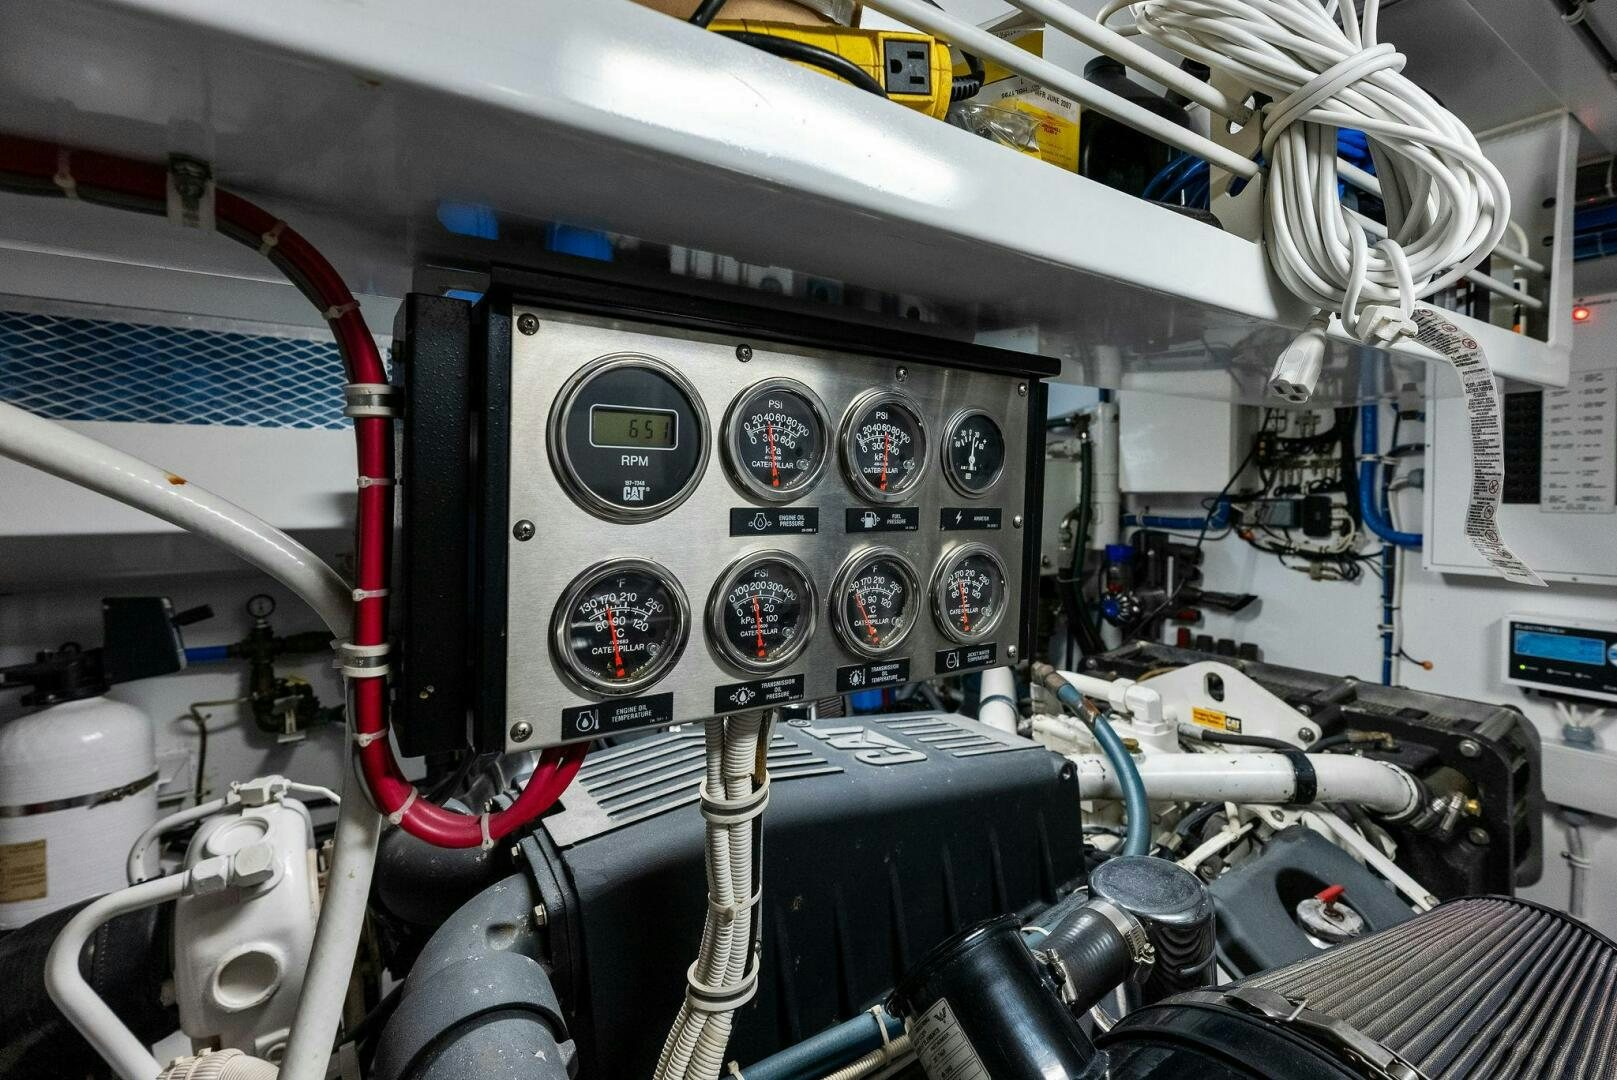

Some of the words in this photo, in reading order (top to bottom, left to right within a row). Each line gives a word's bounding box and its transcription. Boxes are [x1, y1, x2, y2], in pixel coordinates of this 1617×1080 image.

[1046, 94, 1060, 105] JUNE
[768, 399, 783, 410] PSI
[875, 411, 889, 420] PSI
[743, 422, 751, 431] 0
[752, 413, 763, 424] 20
[763, 412, 775, 421] 40
[775, 413, 787, 422] 60
[786, 417, 798, 427] 80
[797, 423, 809, 437] 100
[862, 424, 872, 435] 20
[872, 423, 882, 431] 40
[881, 423, 892, 432] 60
[890, 426, 901, 436] 80
[900, 431, 911, 444] 100
[750, 436, 757, 445] 0
[780, 435, 796, 449] 600
[871, 442, 885, 451] 300
[621, 455, 649, 467] RPM
[623, 486, 646, 501] CAT
[754, 568, 769, 578] PSI
[965, 569, 976, 577] 210
[860, 576, 872, 586] 170
[873, 575, 885, 585] 210
[889, 581, 903, 594] 250
[729, 594, 736, 603] 0
[735, 584, 749, 596] 100
[750, 581, 767, 591] 200
[767, 581, 784, 593] 300
[783, 587, 797, 601] 400
[579, 599, 598, 614] 130
[599, 592, 617, 604] 170
[619, 592, 638, 602] 210
[645, 597, 664, 613] 250
[736, 608, 744, 617] 0
[763, 603, 775, 613] 20
[595, 619, 609, 632] 60
[612, 616, 626, 626] 90
[632, 618, 649, 632] 120
[740, 616, 756, 625] kPa
[765, 614, 779, 623] 100
[761, 678, 796, 689] TRANSMISSION
[611, 710, 653, 723] TEMPERATURE
[615, 706, 637, 715] ENGINE
